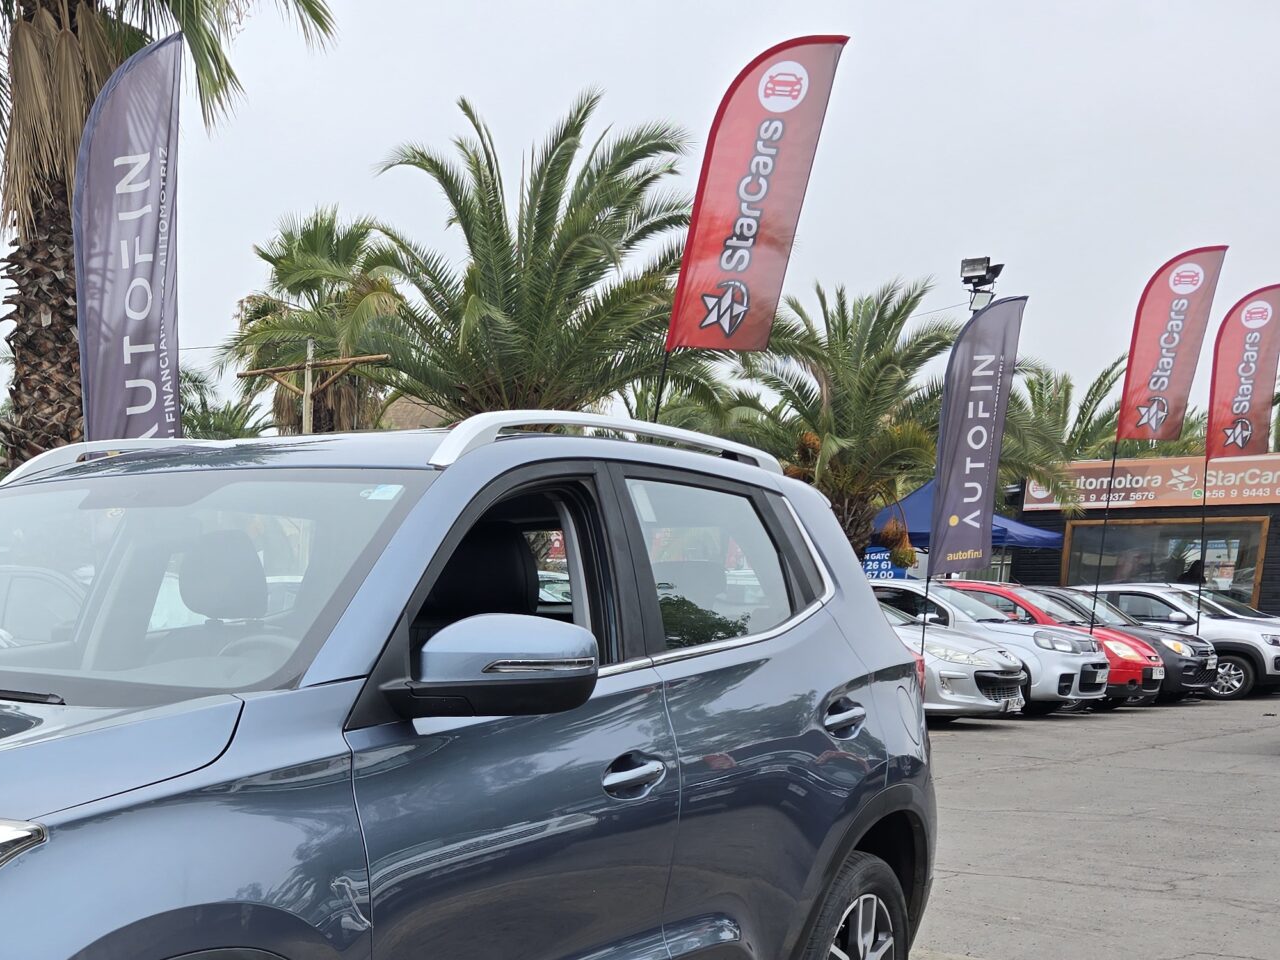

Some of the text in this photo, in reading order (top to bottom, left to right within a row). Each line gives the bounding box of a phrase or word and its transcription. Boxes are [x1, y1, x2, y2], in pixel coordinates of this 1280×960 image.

[721, 119, 783, 272] StarCars
[1149, 298, 1189, 392] StarCars
[1233, 331, 1261, 414] StarCars
[962, 355, 996, 529] AUTOFIN
[1059, 473, 1163, 490] tomotora
[1129, 491, 1156, 501] 5676
[1230, 488, 1237, 497] 9
[1242, 487, 1270, 497] 9443
